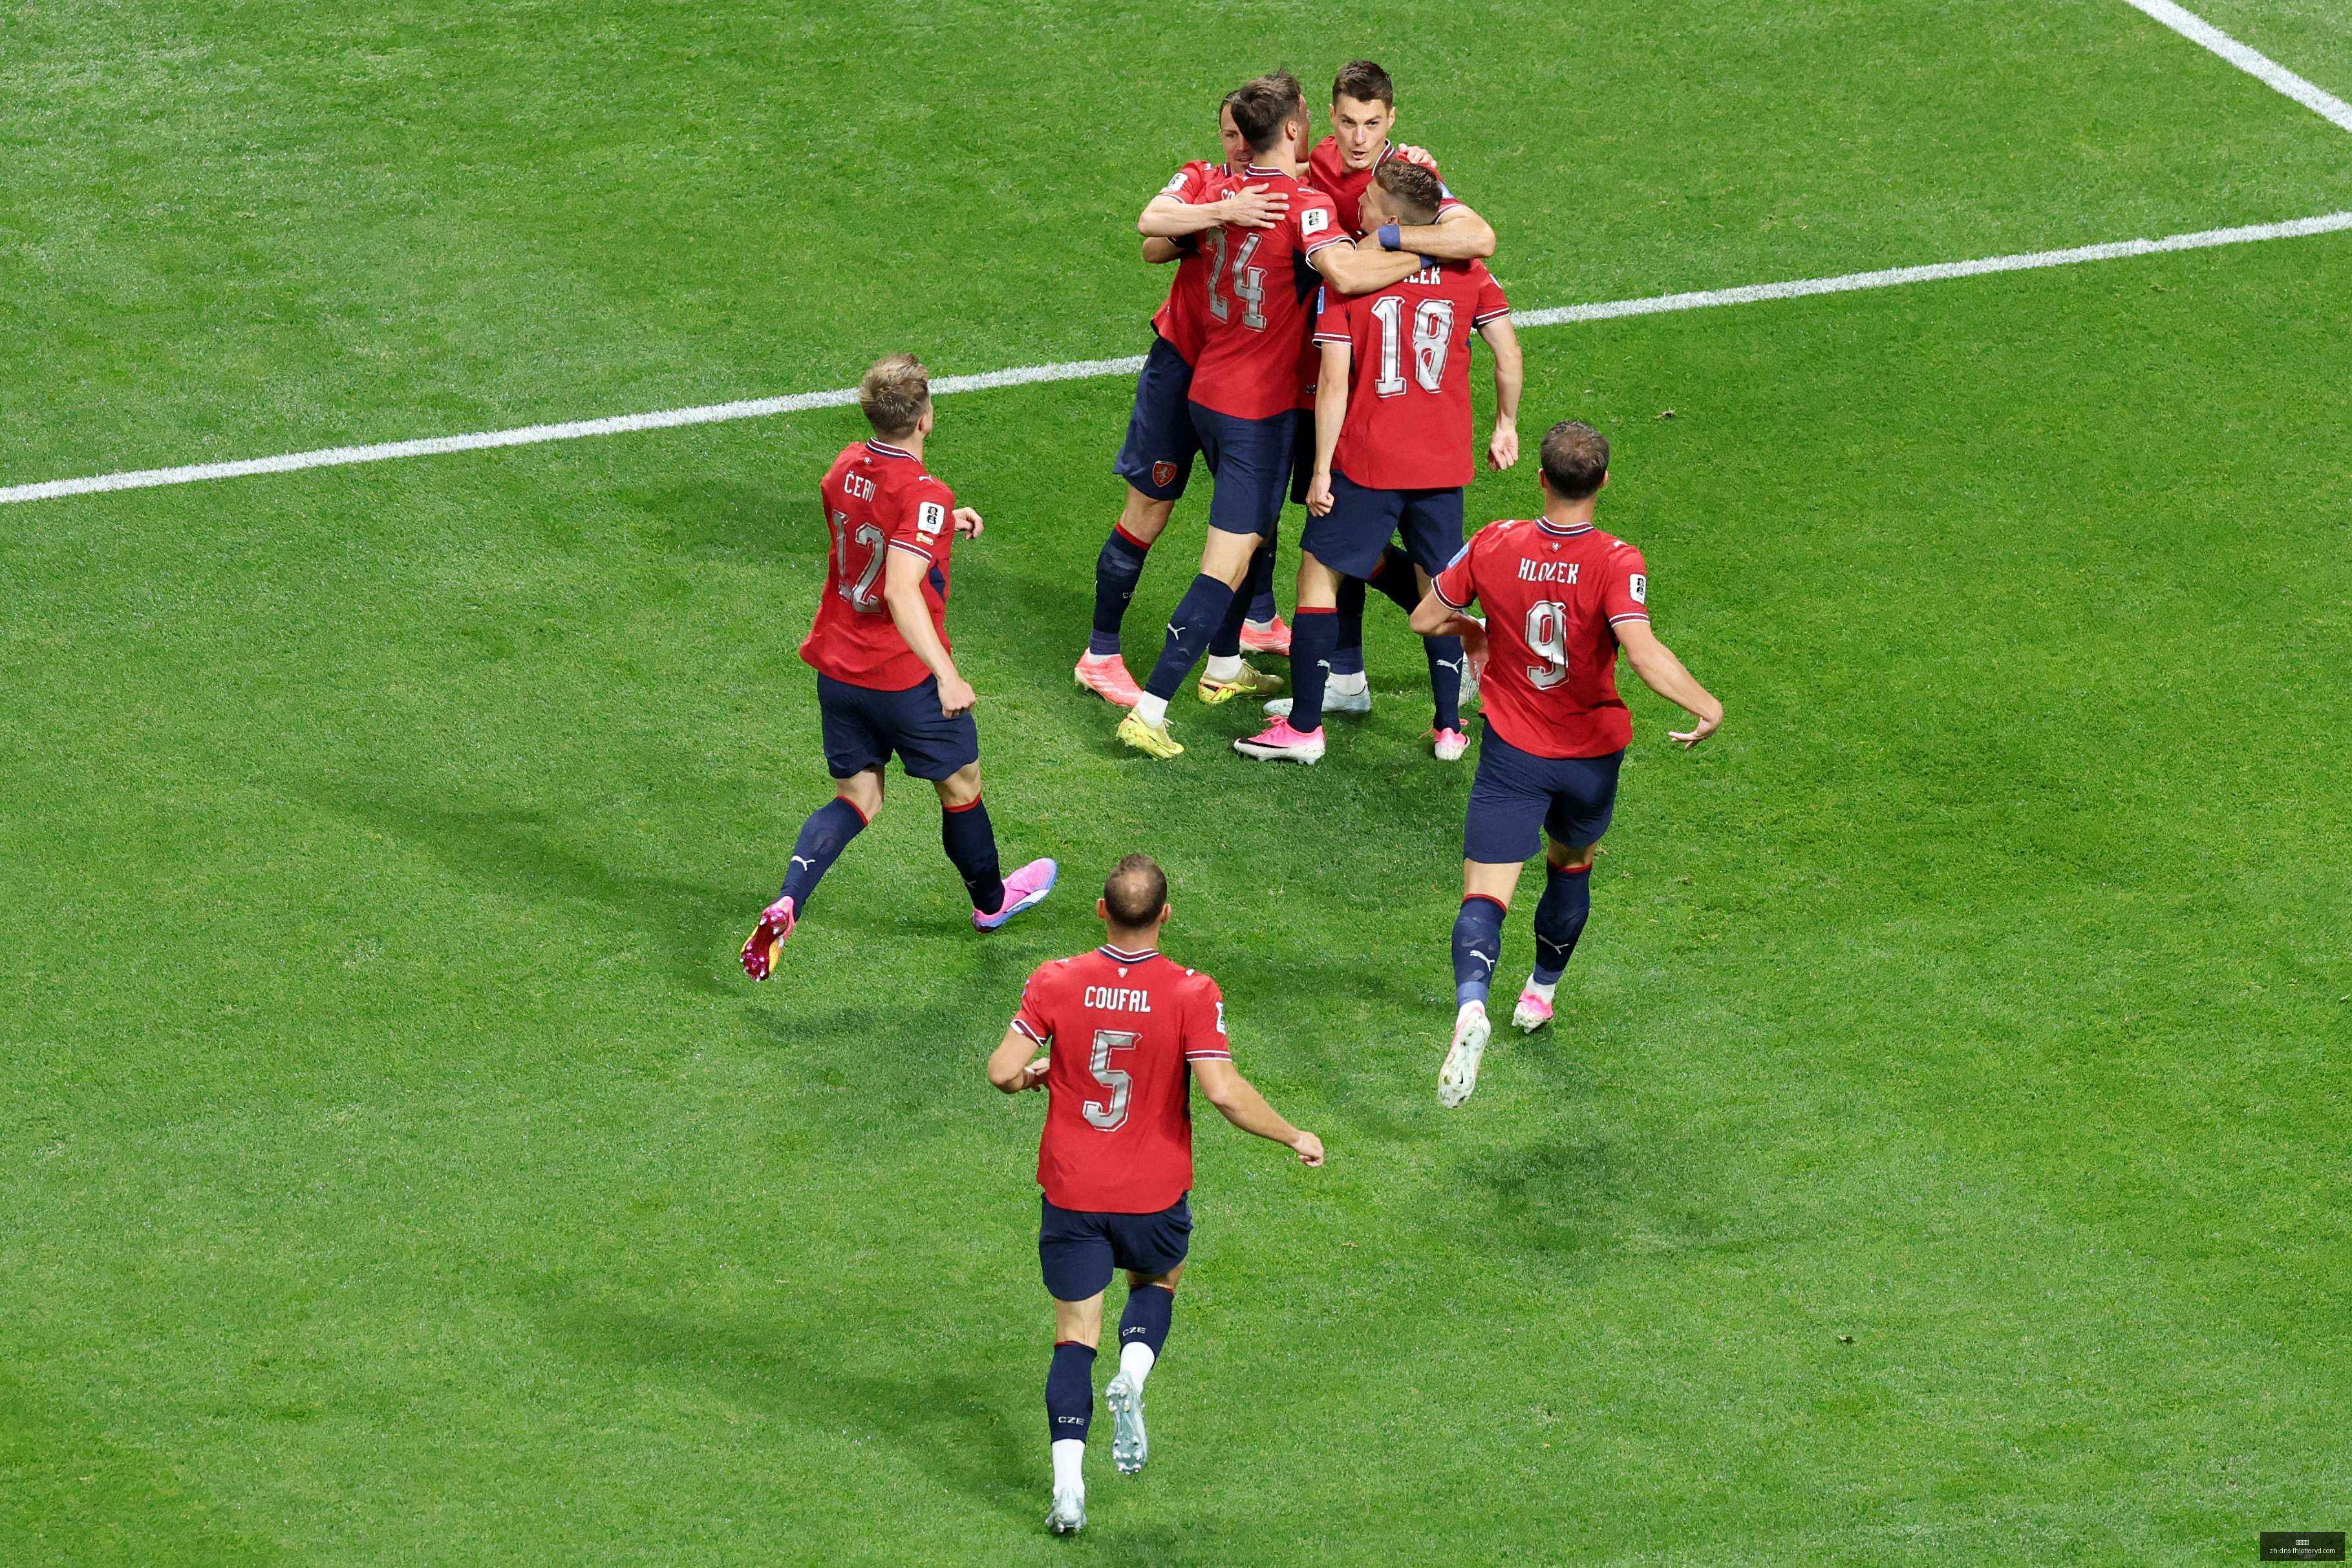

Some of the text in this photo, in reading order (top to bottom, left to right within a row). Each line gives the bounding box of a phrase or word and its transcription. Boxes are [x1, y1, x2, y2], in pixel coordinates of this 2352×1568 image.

[1205, 225, 1268, 332] 24
[1371, 295, 1455, 397] 18
[833, 509, 886, 618] 12
[1524, 600, 1569, 691] 9
[1084, 986, 1151, 1012] COUFAL
[1082, 1029, 1143, 1132] 5
[1122, 1326, 1146, 1337] CZE
[1058, 1416, 1085, 1426] CZE
